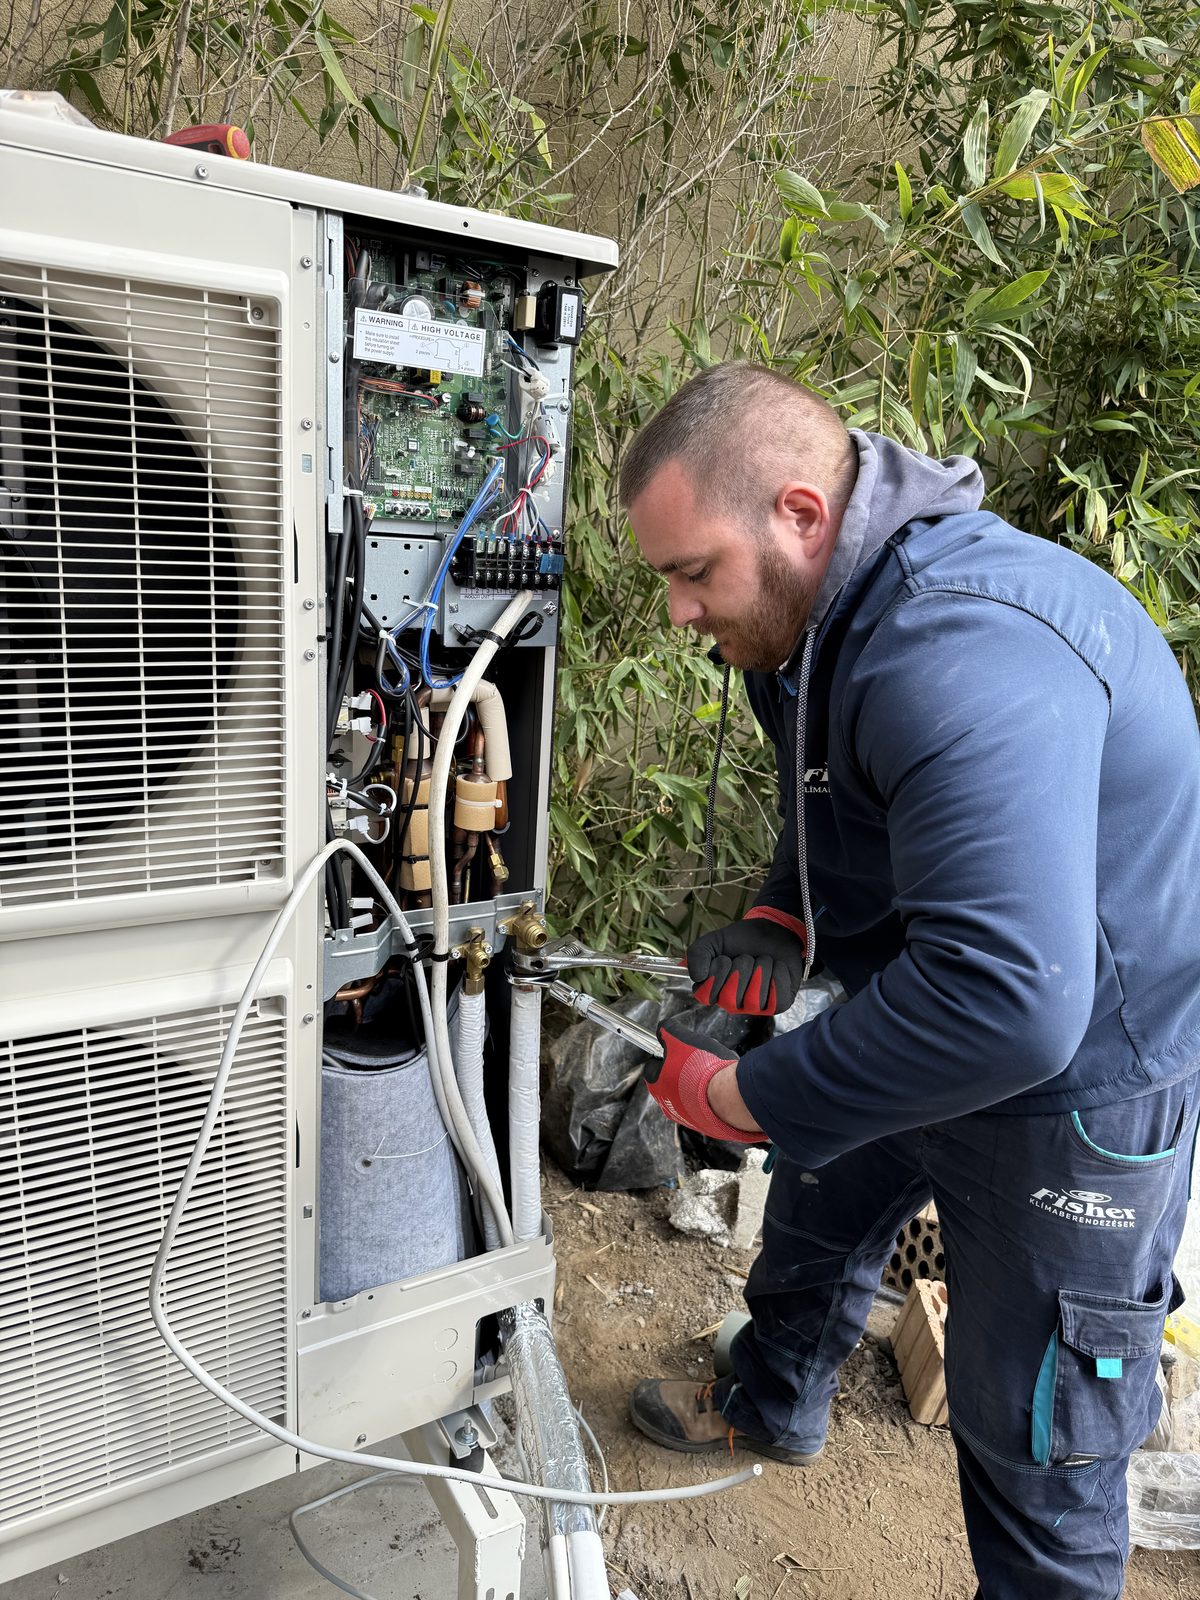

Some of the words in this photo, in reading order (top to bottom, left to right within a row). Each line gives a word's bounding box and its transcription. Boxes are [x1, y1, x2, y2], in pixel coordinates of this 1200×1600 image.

[369, 316, 404, 328] WARNING
[421, 324, 441, 334] HIGH
[444, 329, 481, 341] VOLTAGE
[1029, 1198, 1136, 1228] KLÍMABERENDEZÉSEK
[1030, 1187, 1136, 1220] Fisher
